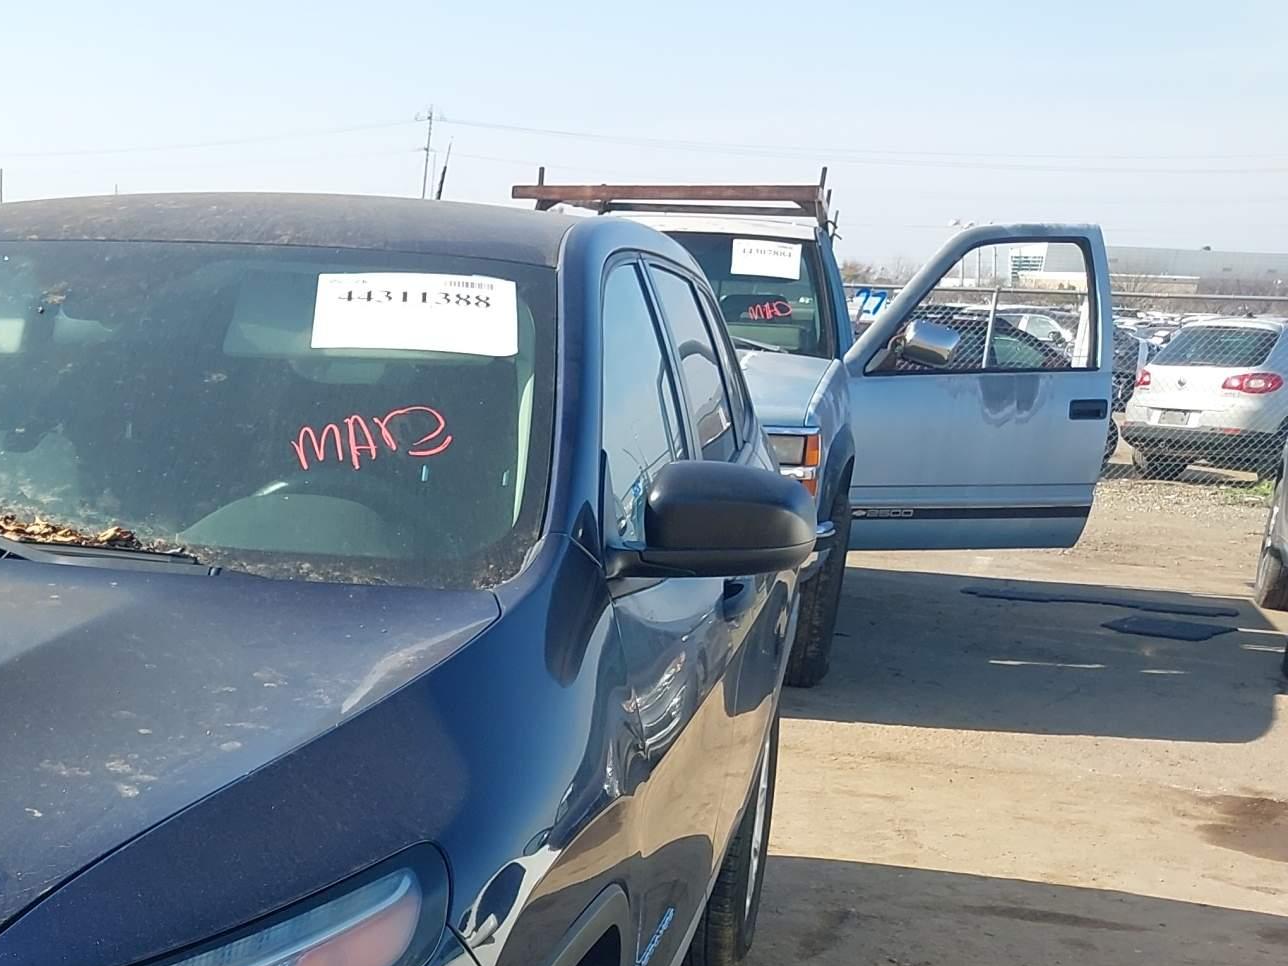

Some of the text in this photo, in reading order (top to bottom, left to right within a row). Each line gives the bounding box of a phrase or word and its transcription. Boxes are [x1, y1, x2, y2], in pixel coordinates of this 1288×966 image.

[337, 289, 492, 309] 44311388
[855, 287, 888, 316] 27
[866, 509, 914, 518] 2500
